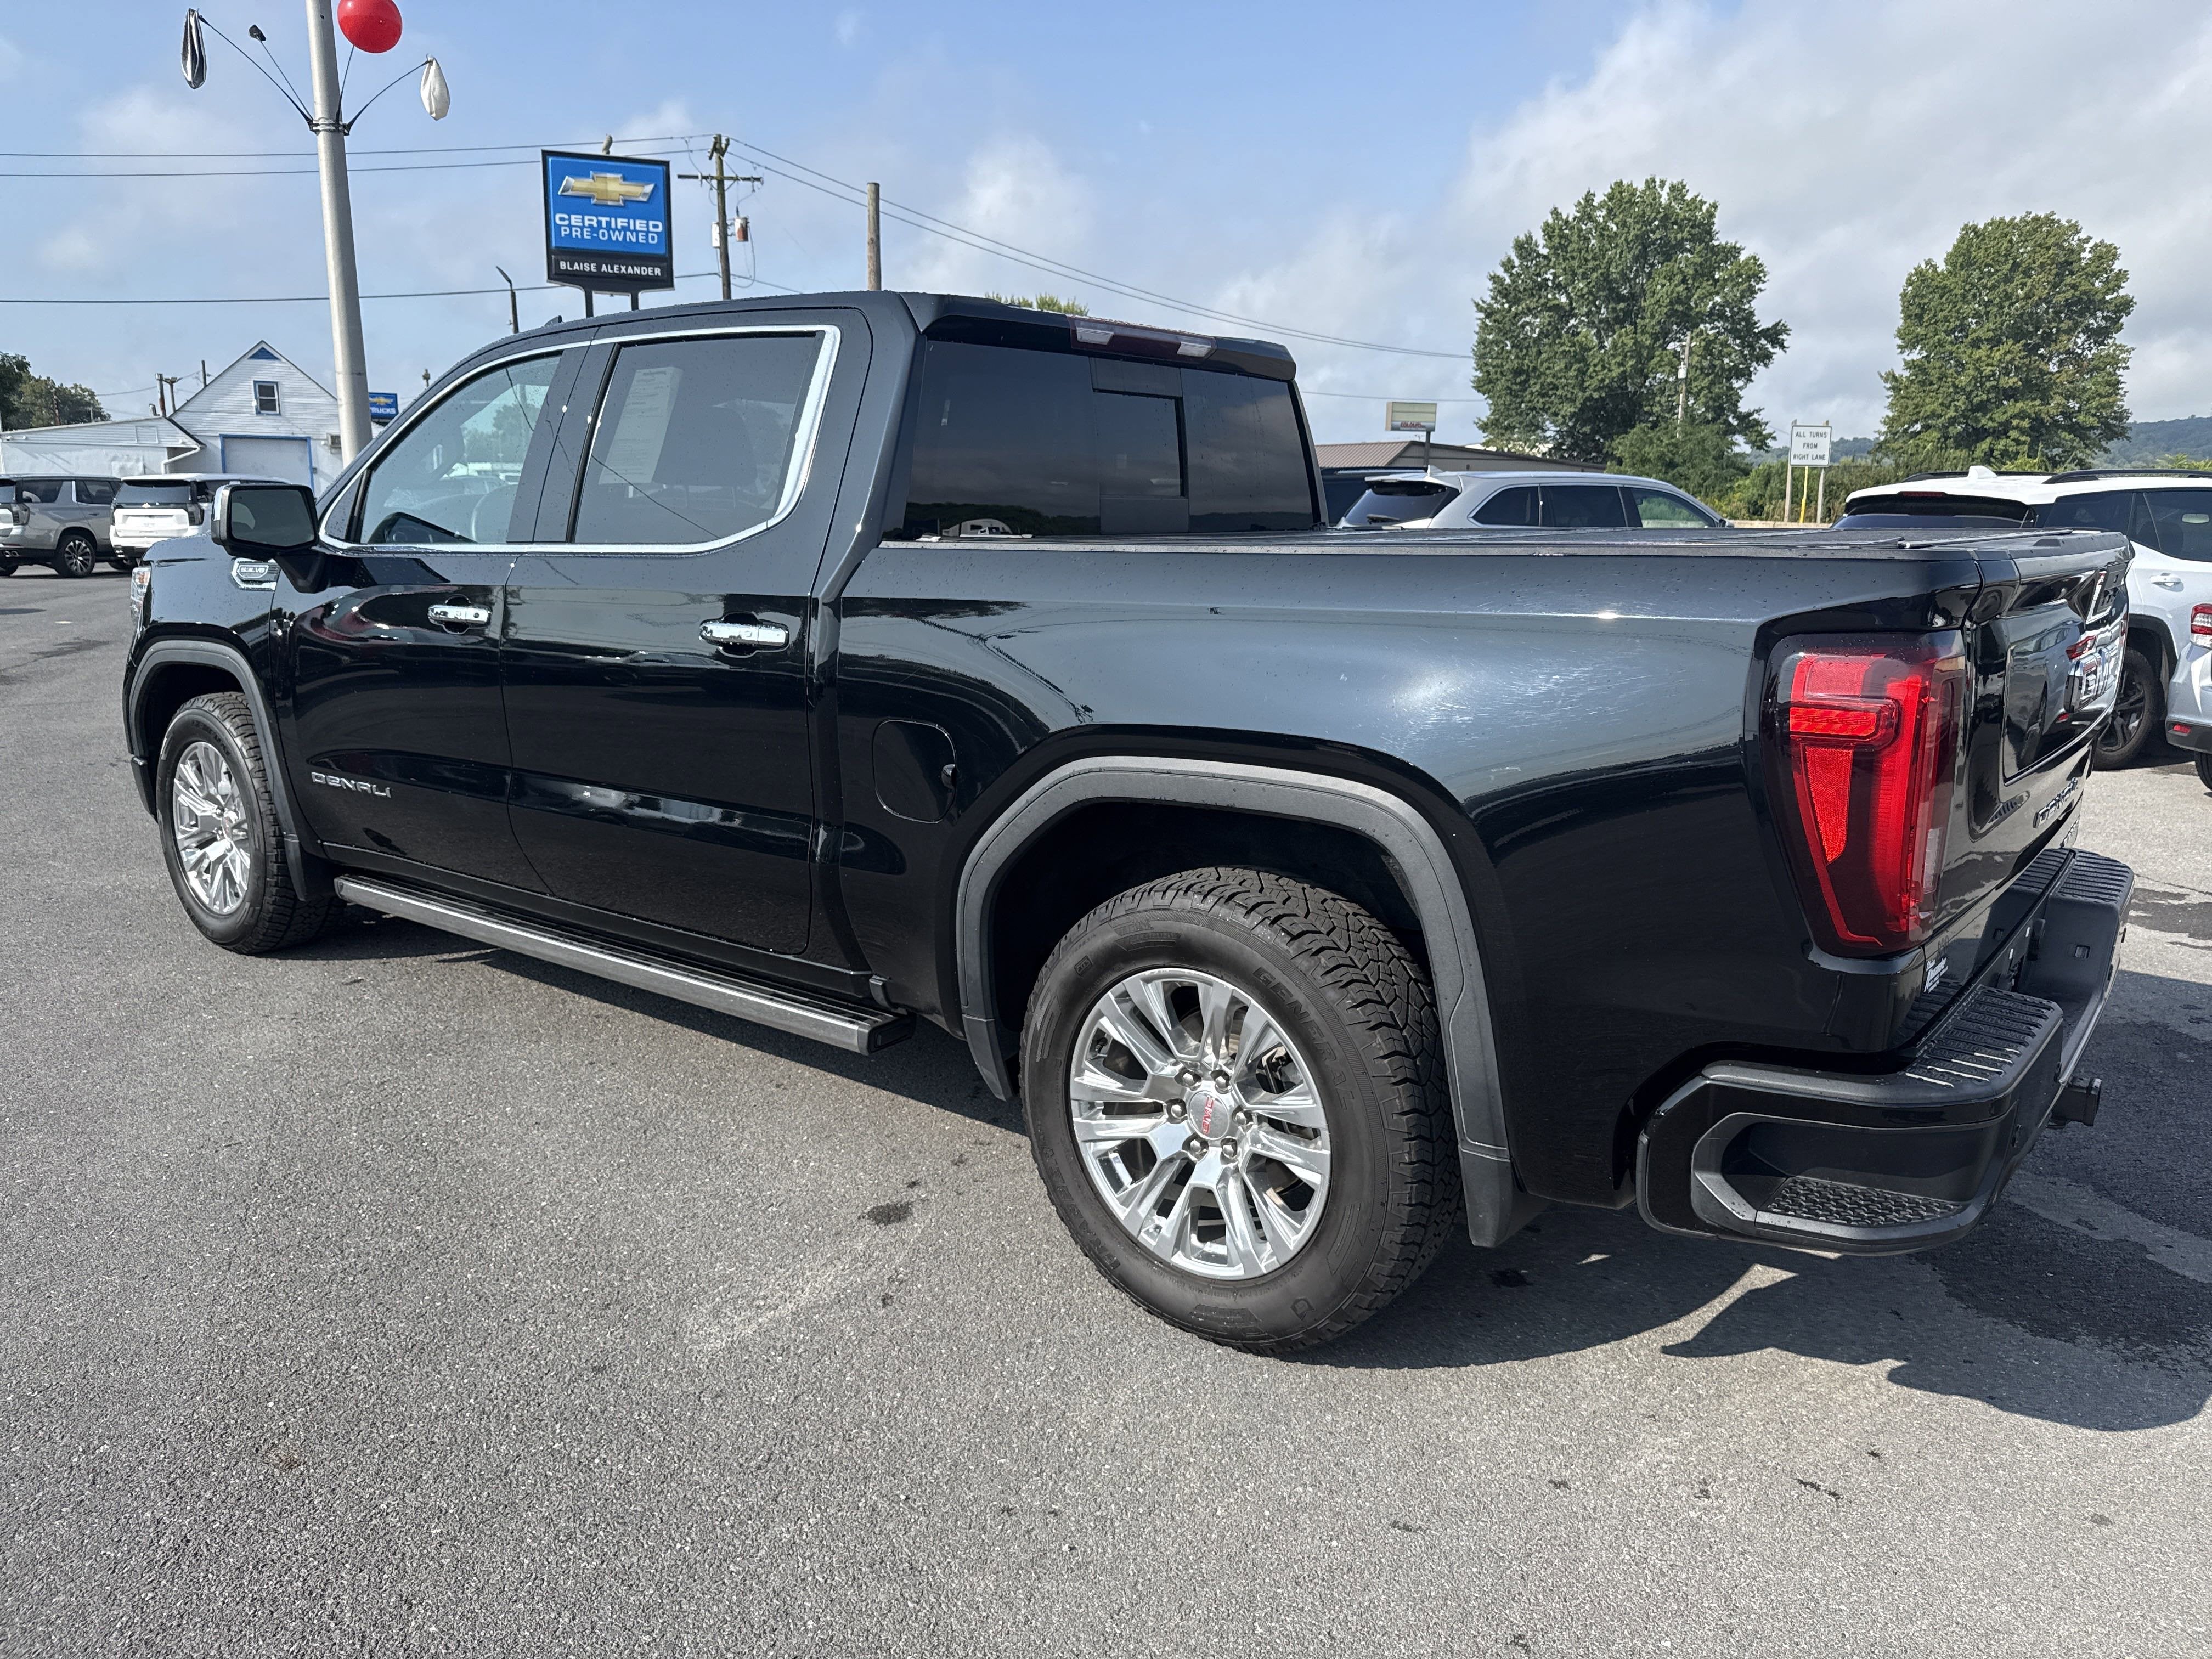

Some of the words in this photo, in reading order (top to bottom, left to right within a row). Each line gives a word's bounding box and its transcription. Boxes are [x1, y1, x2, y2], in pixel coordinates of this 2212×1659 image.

[555, 213, 663, 233] CERTIFIED
[561, 226, 658, 244] PRE-OWNED
[560, 261, 597, 272] BLAISE
[601, 263, 661, 276] ALEXANDER
[311, 771, 391, 799] DENALI
[1252, 966, 1355, 1110] GENERAL
[1201, 1094, 1216, 1135] GMC
